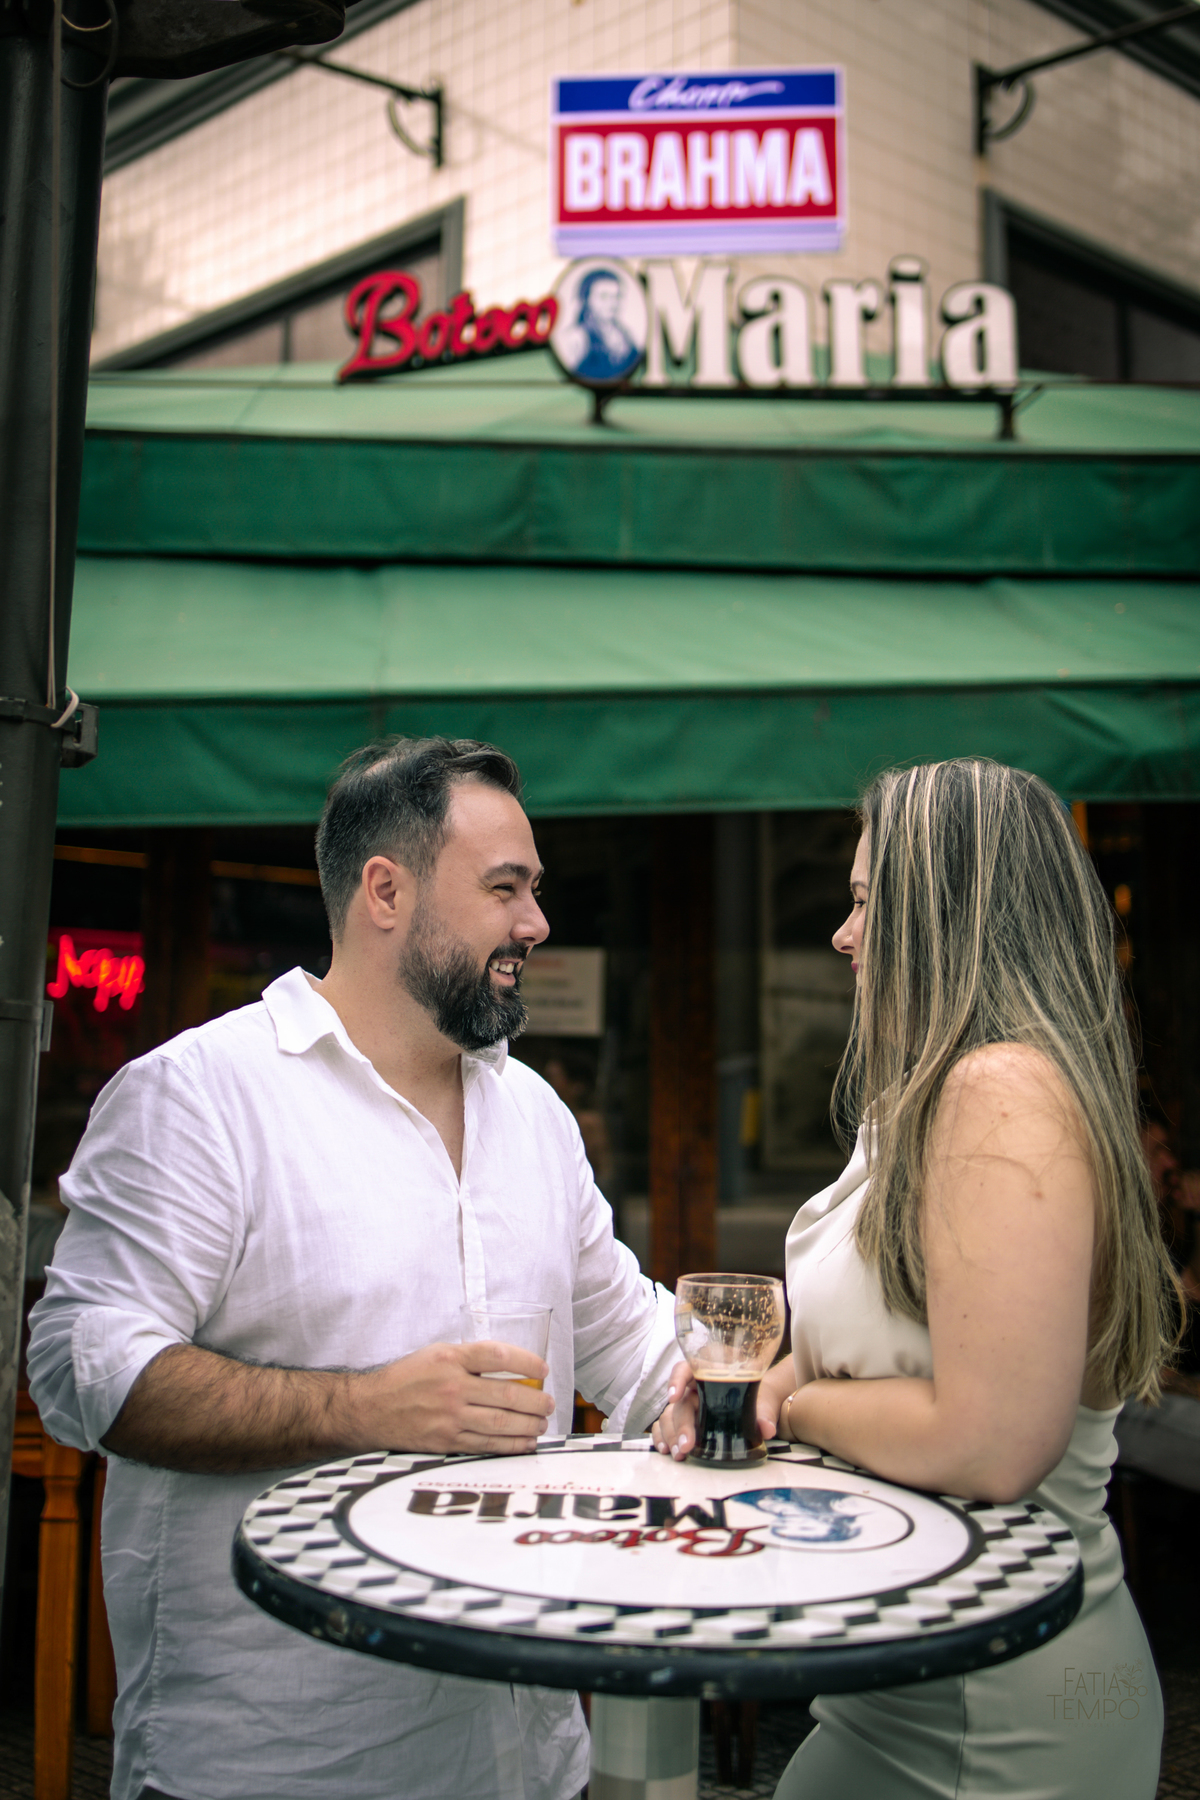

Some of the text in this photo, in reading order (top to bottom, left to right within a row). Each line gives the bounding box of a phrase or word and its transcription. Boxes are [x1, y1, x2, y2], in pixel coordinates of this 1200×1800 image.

[565, 127, 832, 211] BRAHMA
[341, 256, 1018, 389] Boteco Maria
[407, 1489, 730, 1528] Maria
[514, 1525, 769, 1557] Boteco
